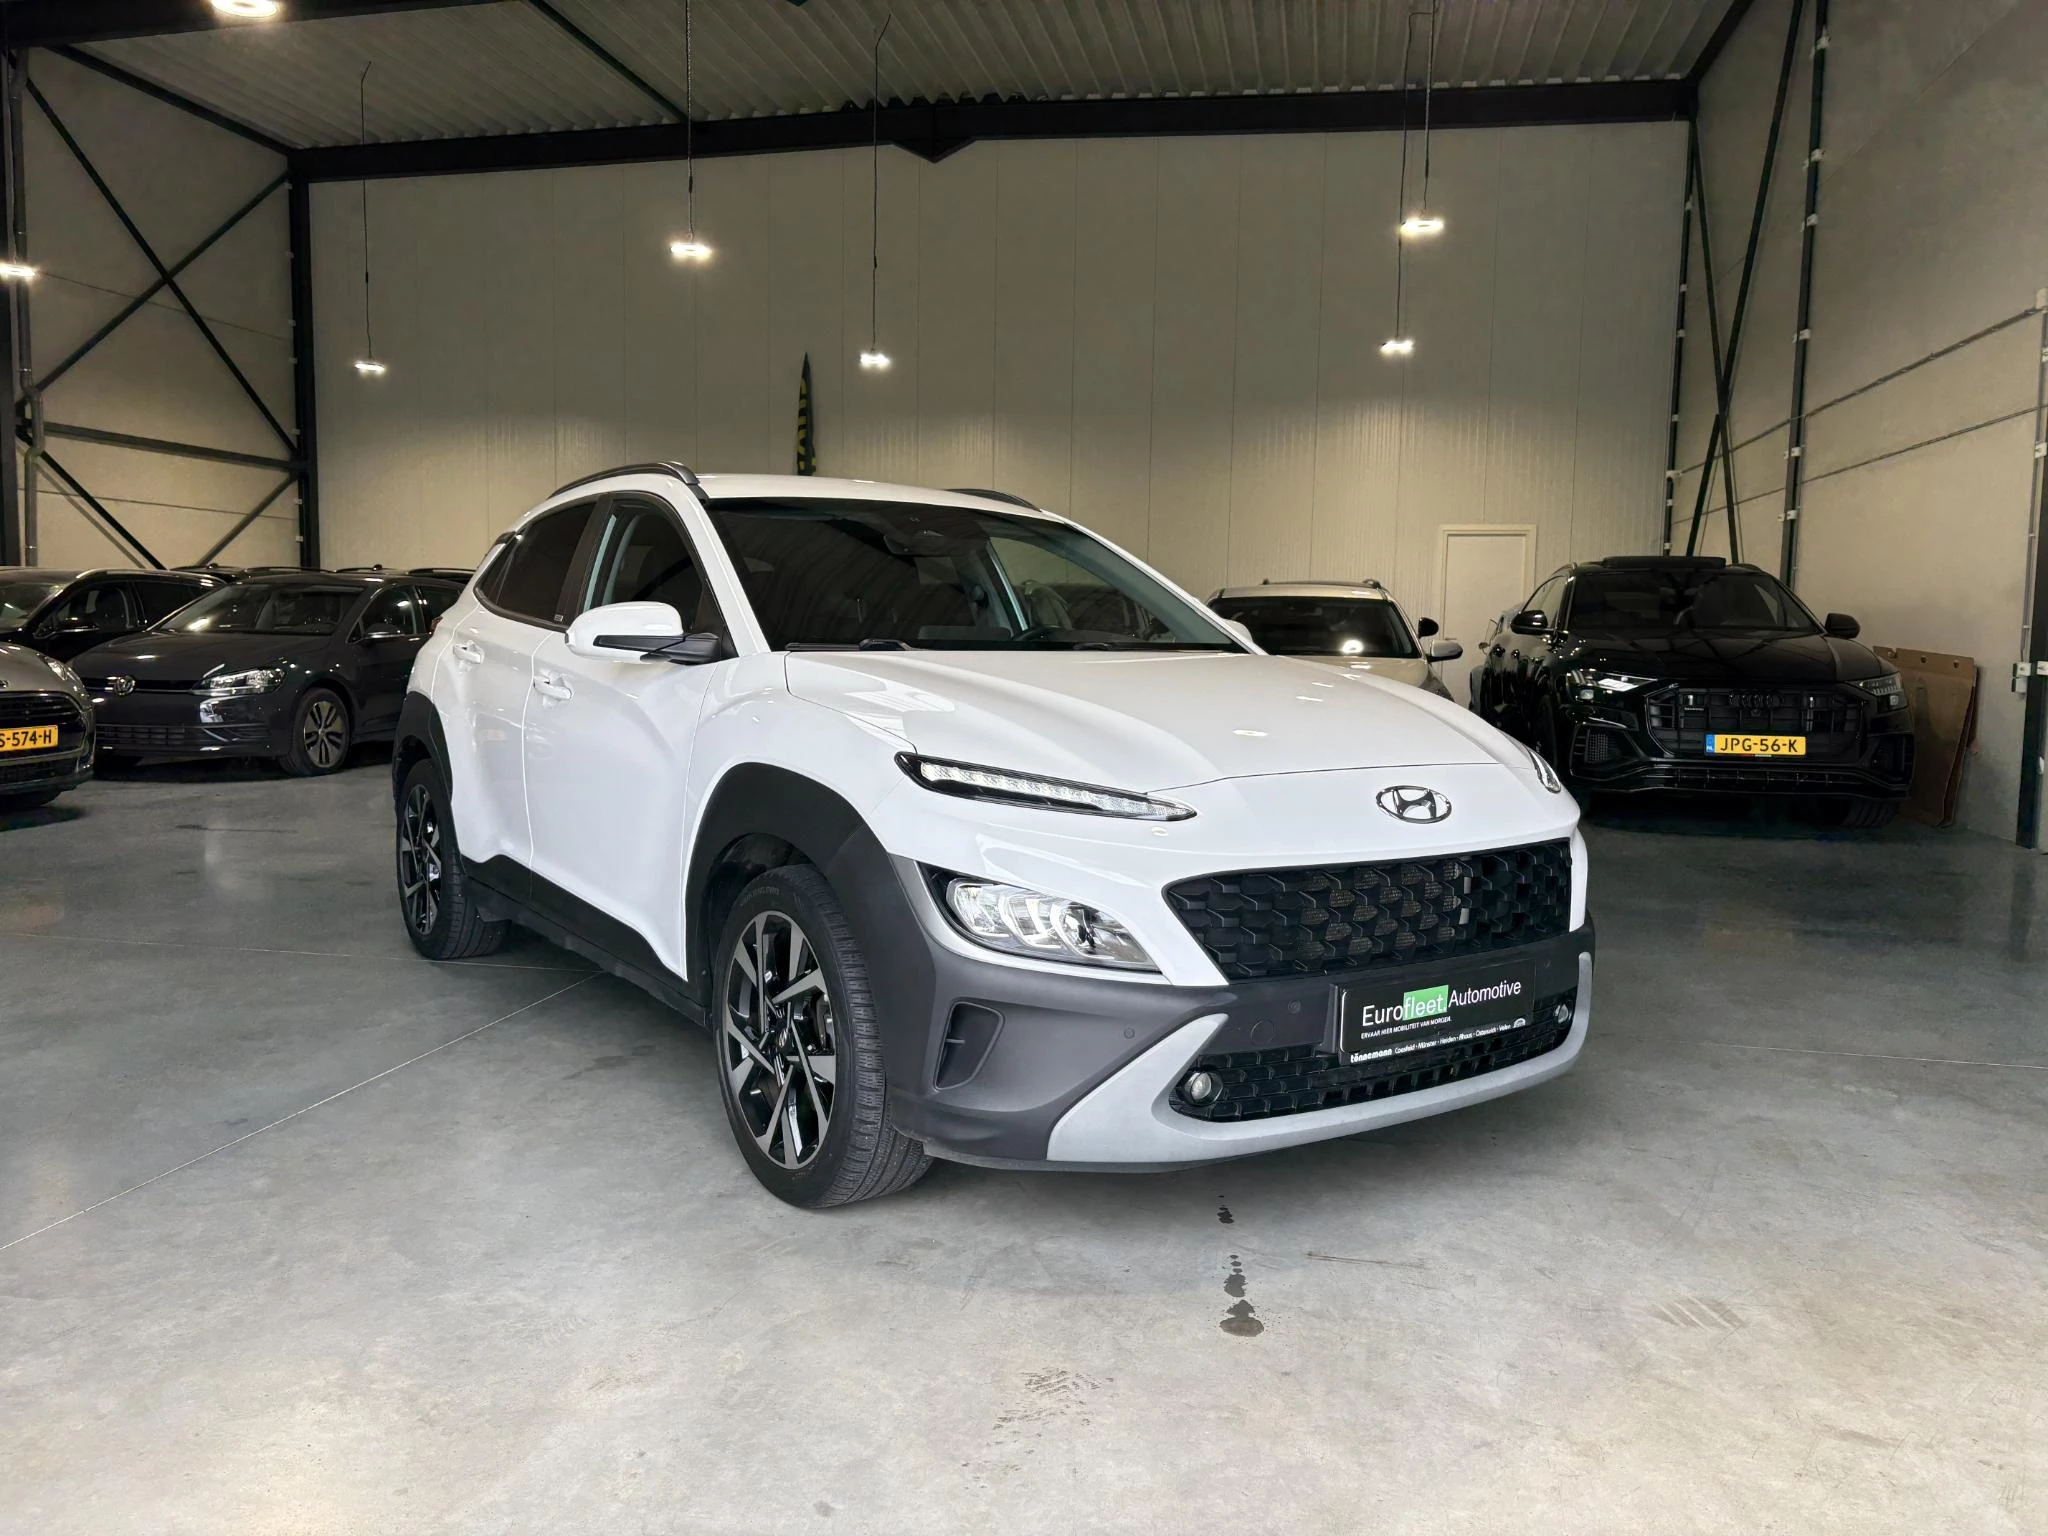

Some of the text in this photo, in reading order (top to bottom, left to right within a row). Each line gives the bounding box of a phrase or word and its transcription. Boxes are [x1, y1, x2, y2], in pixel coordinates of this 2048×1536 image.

[1720, 737, 1798, 752] JPG-56-K
[1448, 980, 1522, 1008] Automotive
[1361, 1029, 1381, 1039] ERVAAR
[1381, 1027, 1393, 1035] HIER
[1393, 1022, 1419, 1033] MOBILITEIT
